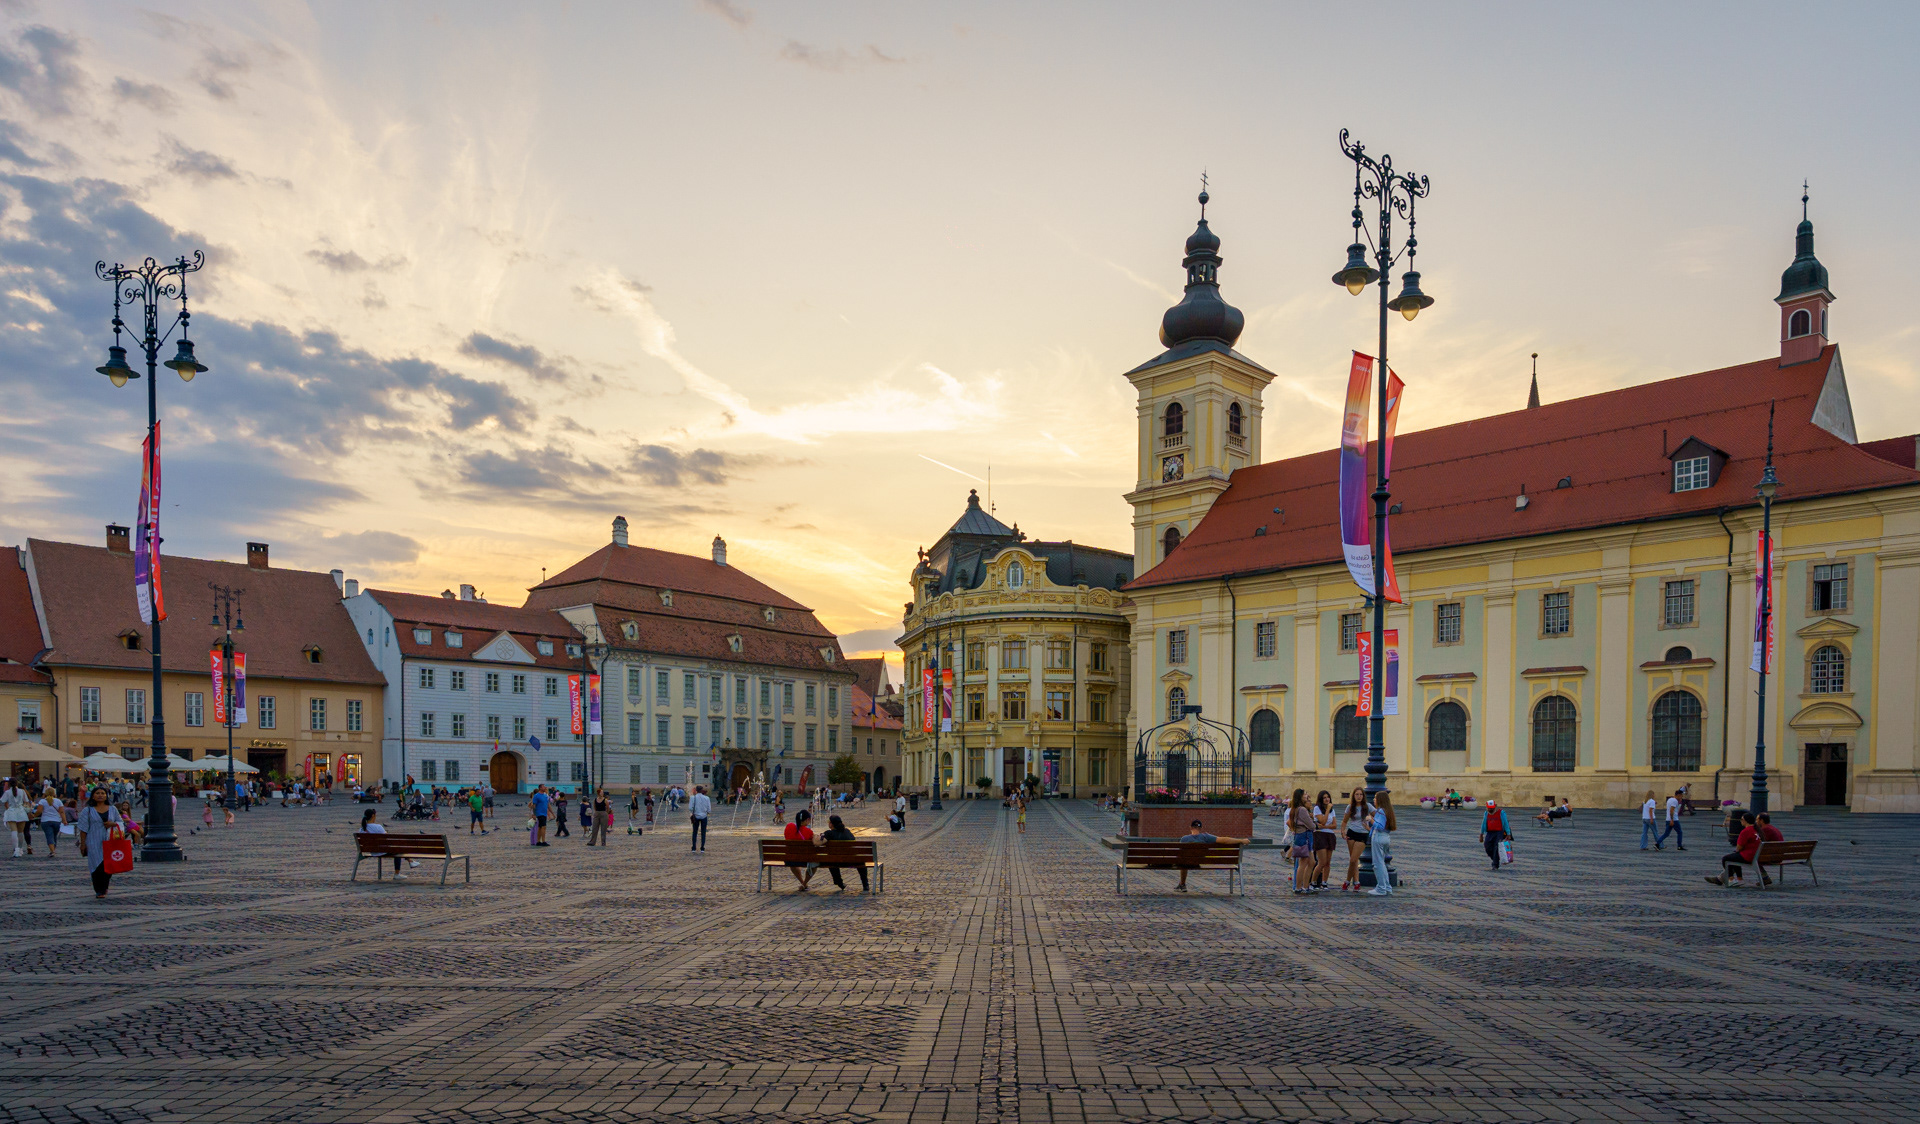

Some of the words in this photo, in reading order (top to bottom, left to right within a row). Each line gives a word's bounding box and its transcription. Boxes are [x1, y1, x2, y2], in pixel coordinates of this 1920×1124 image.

[214, 670, 223, 719] AUMOVIO
[1360, 654, 1371, 711] AUMOVIO
[572, 691, 580, 731] AUMOVIO
